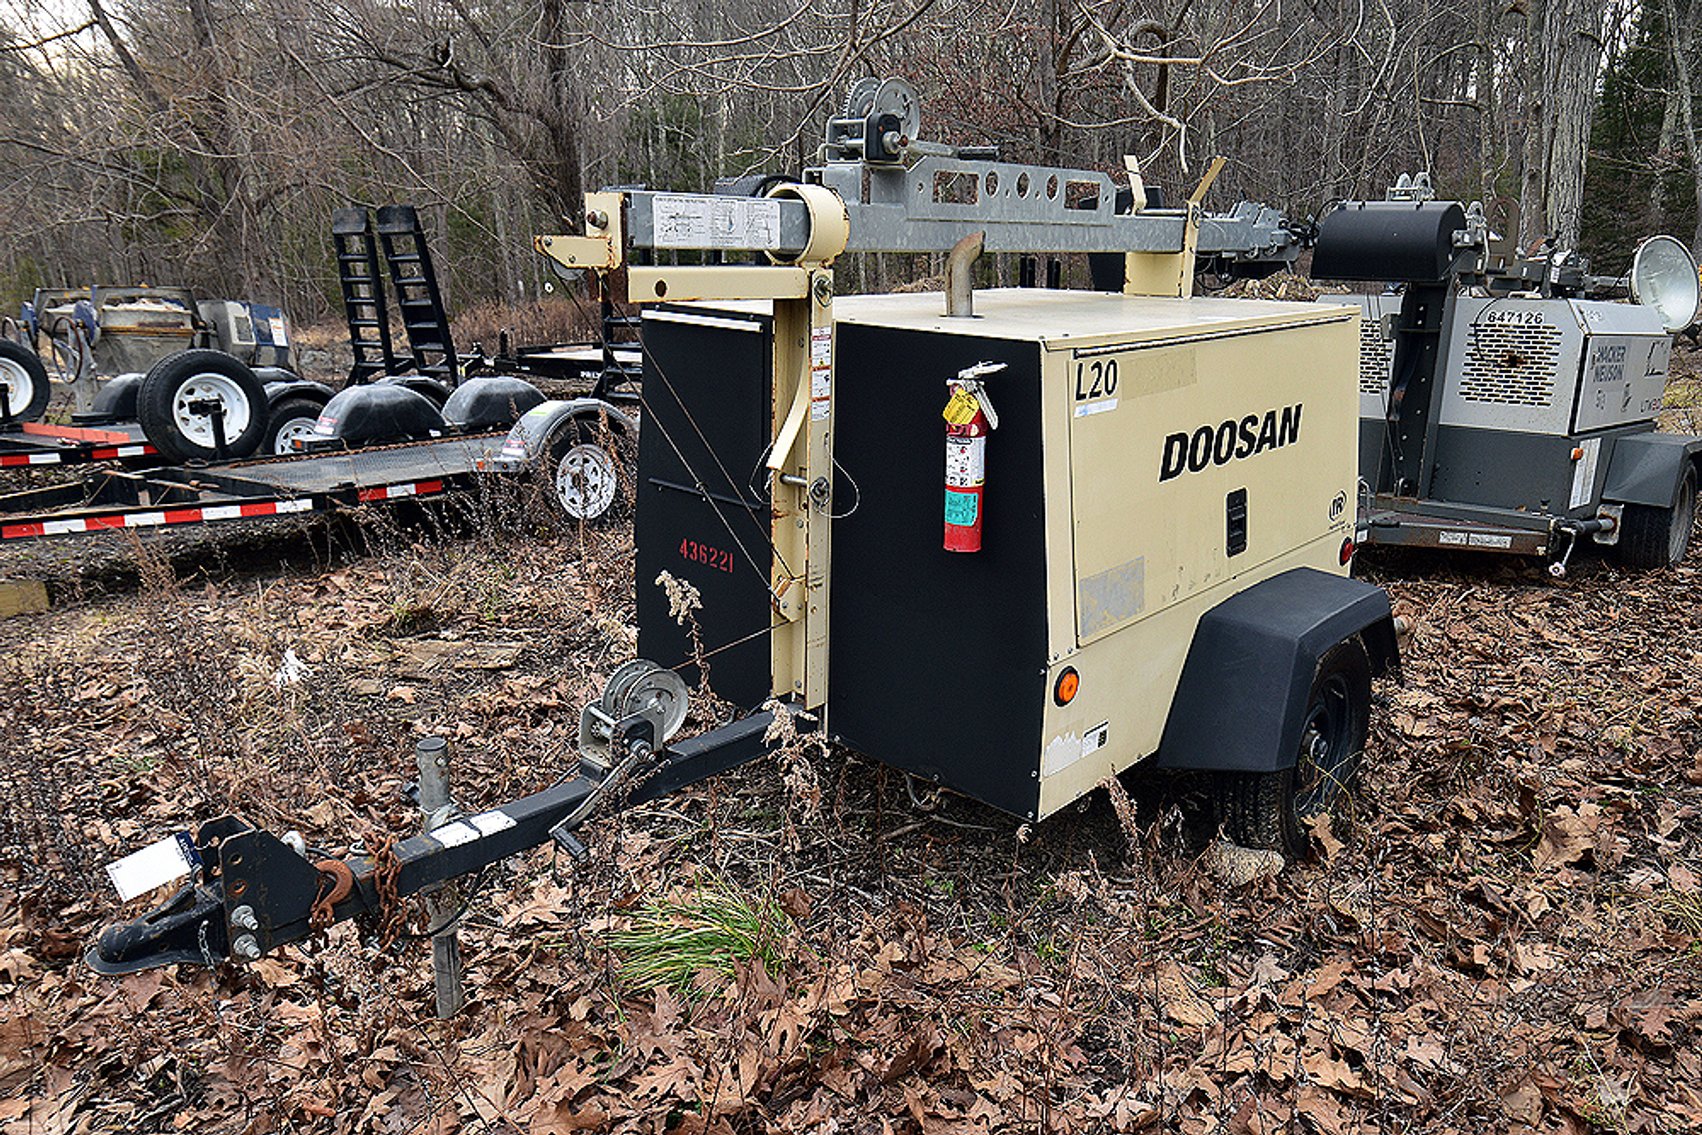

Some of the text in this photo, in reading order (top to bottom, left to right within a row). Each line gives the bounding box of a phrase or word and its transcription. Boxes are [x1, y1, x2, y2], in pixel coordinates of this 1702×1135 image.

[1488, 311, 1543, 324] 647126
[1074, 359, 1118, 401] L20
[1593, 364, 1624, 382] NEUSON
[1159, 403, 1303, 483] DOOSAN
[680, 538, 734, 573] 436221
